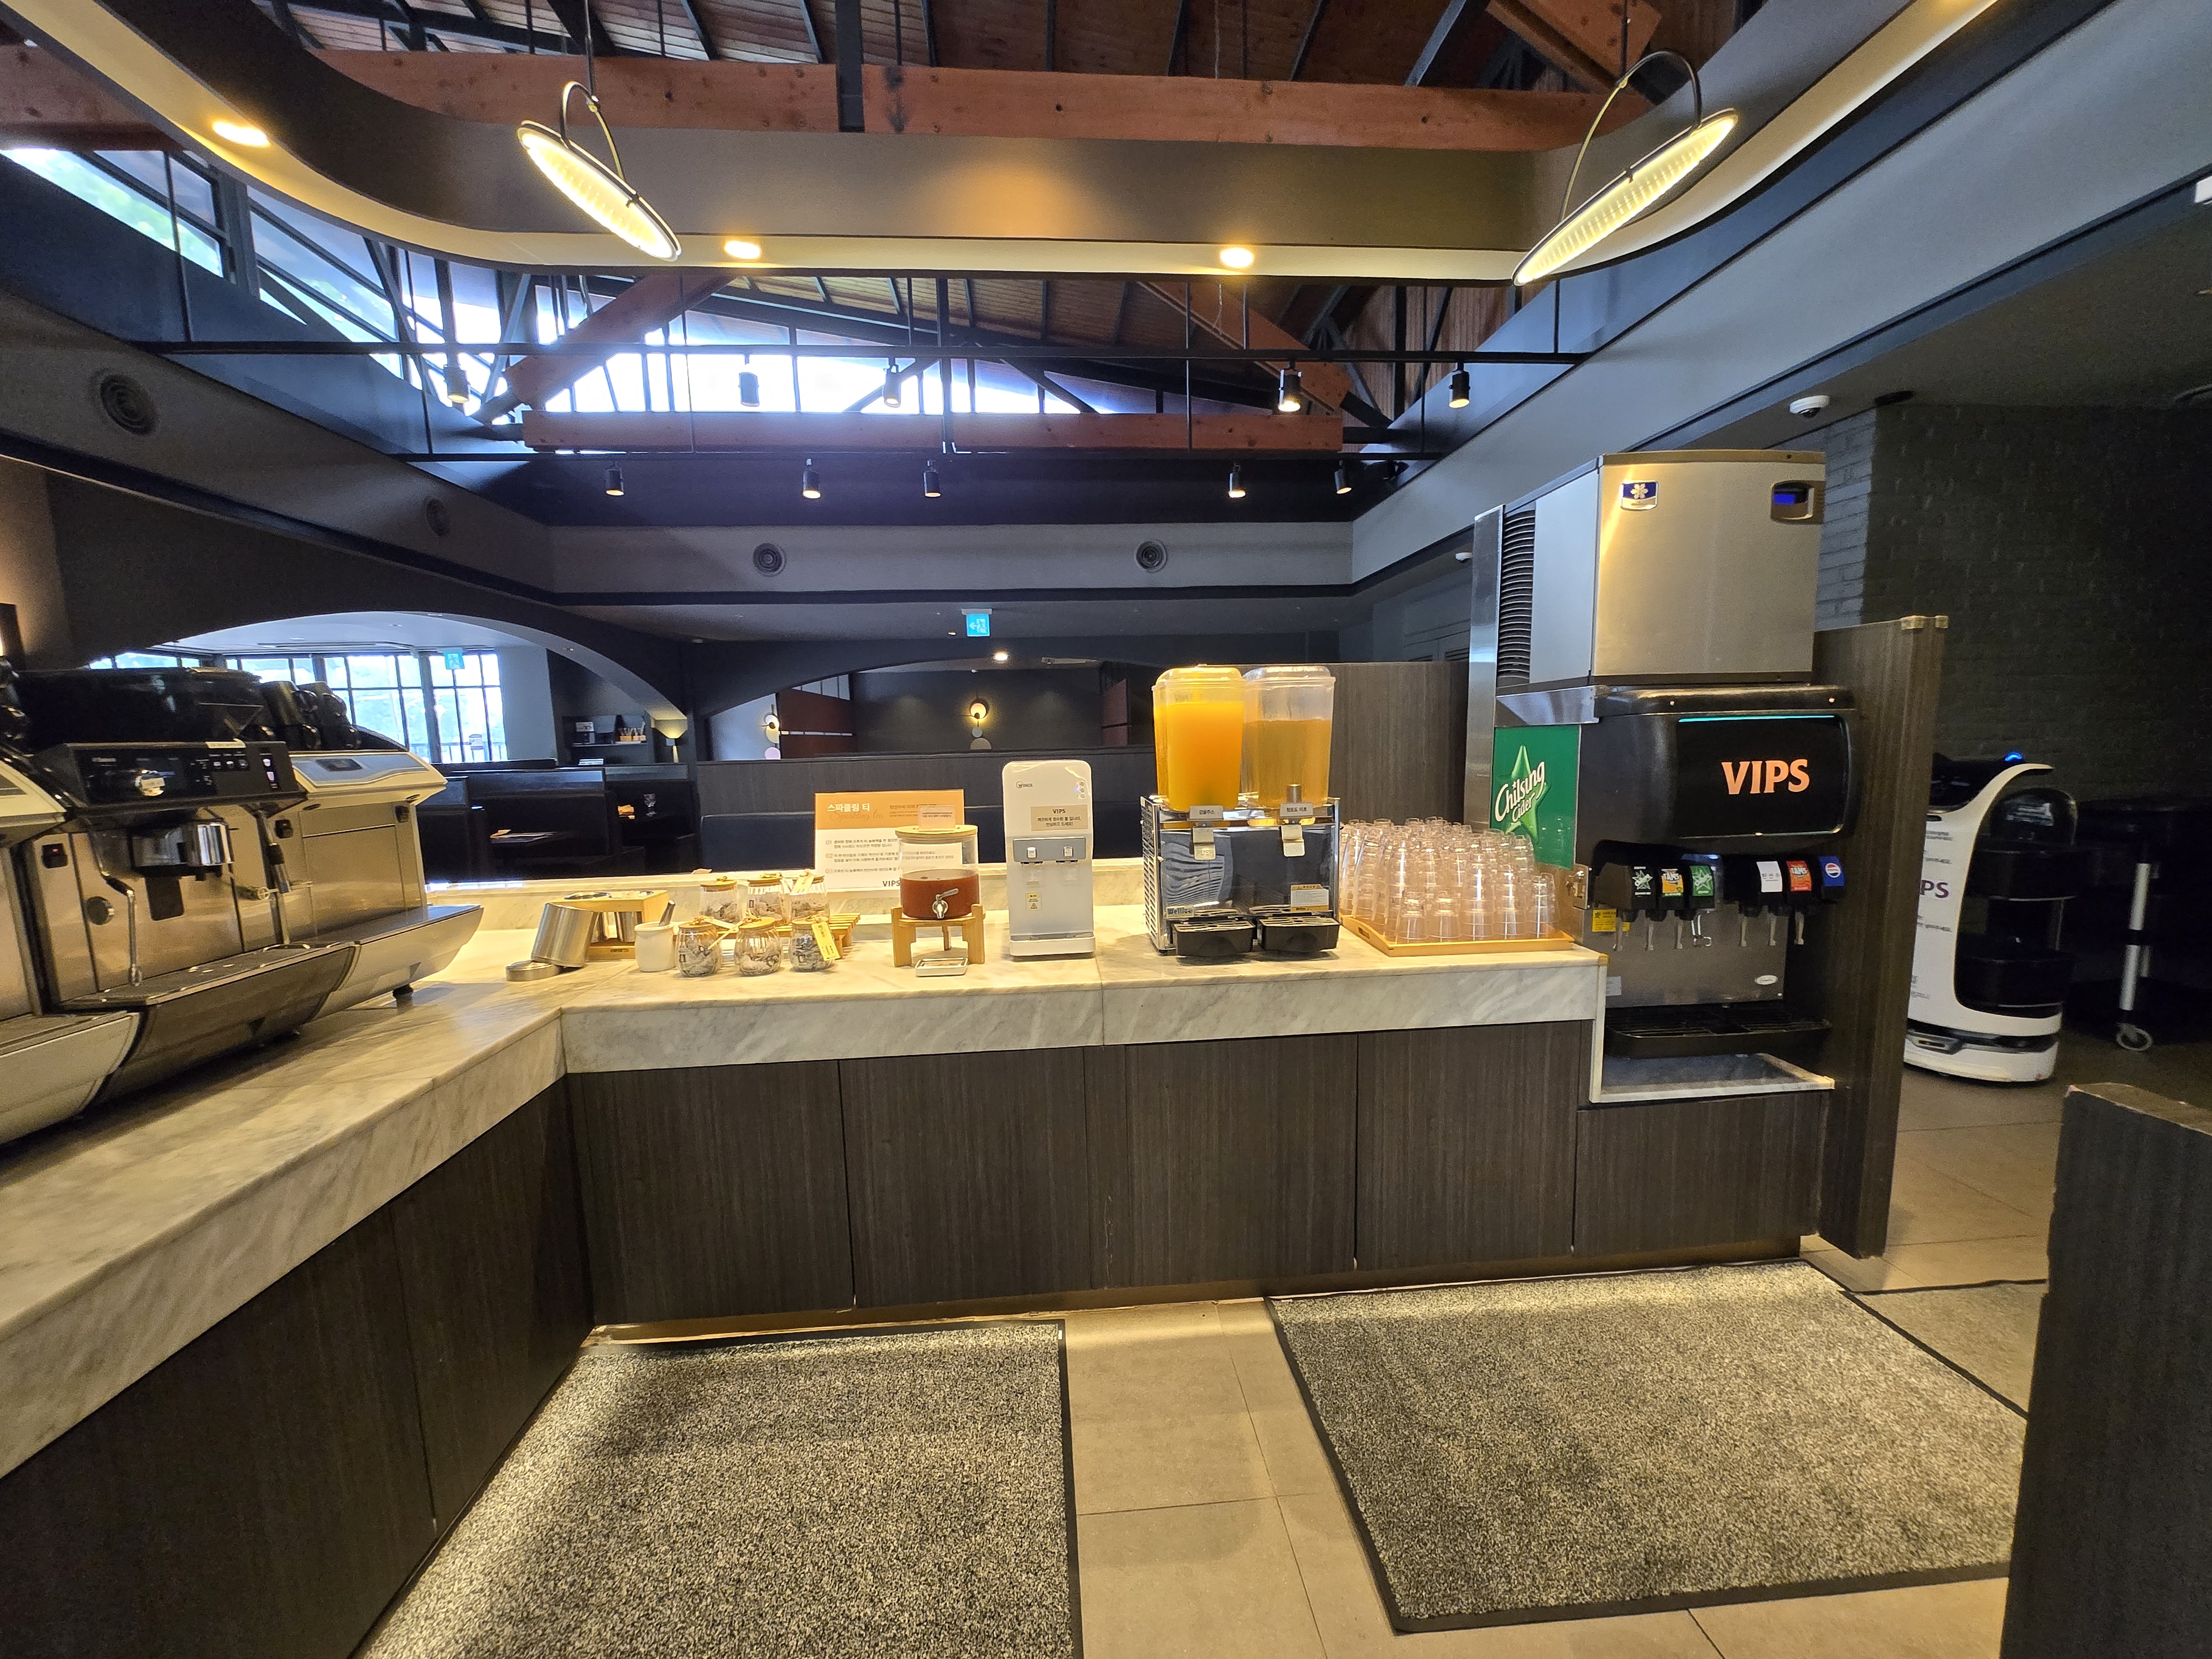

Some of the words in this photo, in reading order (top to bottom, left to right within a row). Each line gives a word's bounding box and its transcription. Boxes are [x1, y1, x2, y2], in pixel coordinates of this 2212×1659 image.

[1721, 759, 1810, 795] VIPS
[1495, 761, 1545, 822] Chilsung
[827, 803, 859, 812] 스파클링
[862, 802, 869, 812] 티
[1919, 879, 1949, 899] PS
